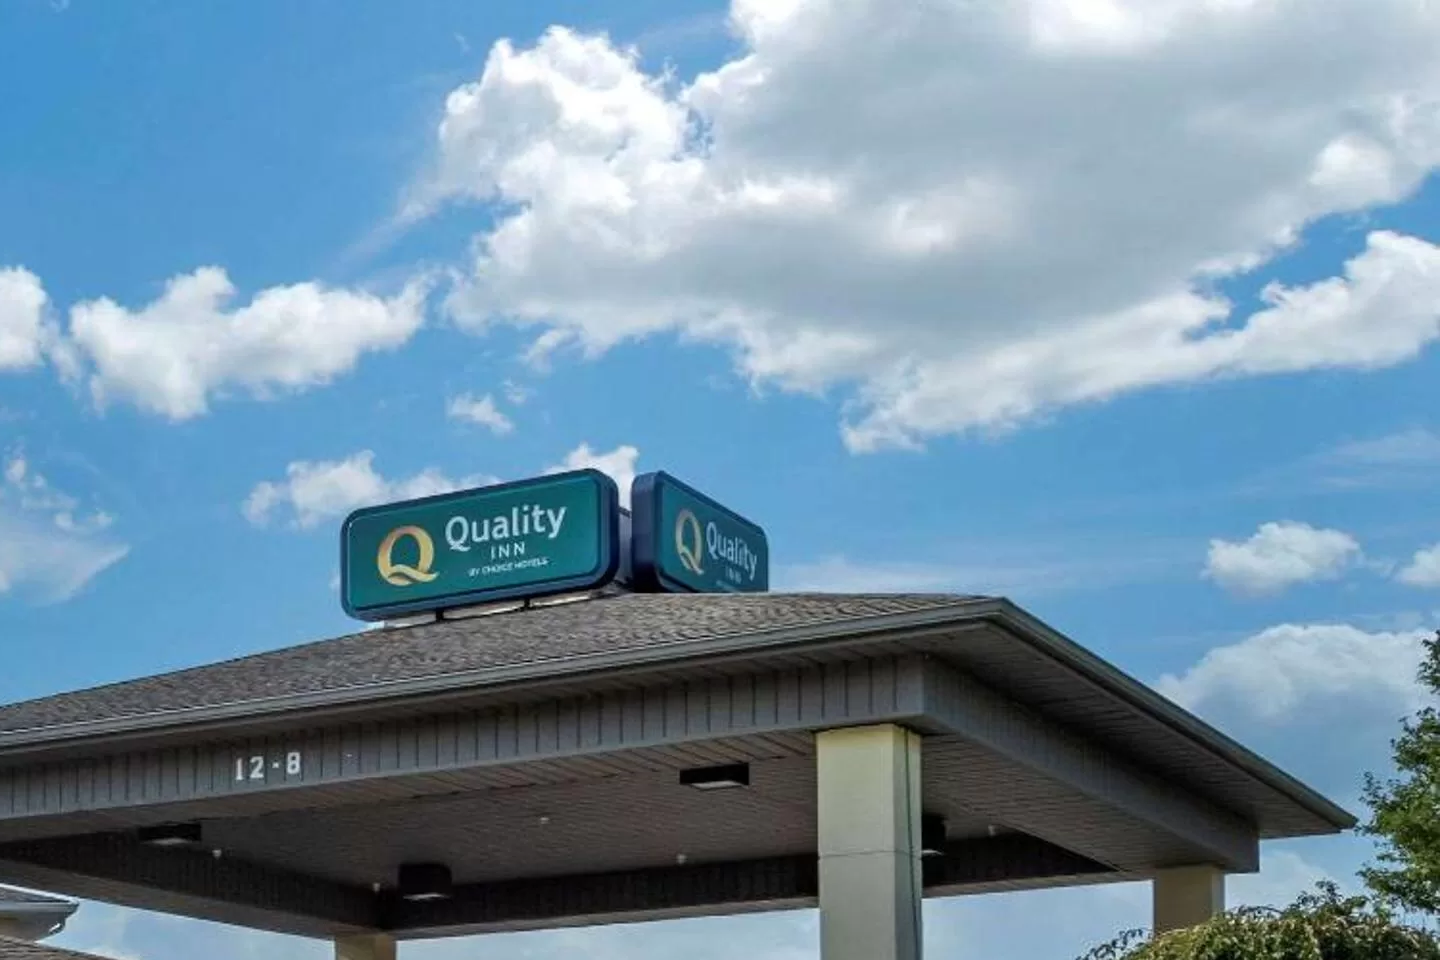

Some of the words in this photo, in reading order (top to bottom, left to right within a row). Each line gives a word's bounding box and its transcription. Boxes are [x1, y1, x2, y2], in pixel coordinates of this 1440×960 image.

[378, 525, 440, 587] Q
[445, 504, 567, 552] Quality
[491, 541, 526, 560] INN
[675, 509, 705, 576] Q
[706, 521, 757, 581] Quality
